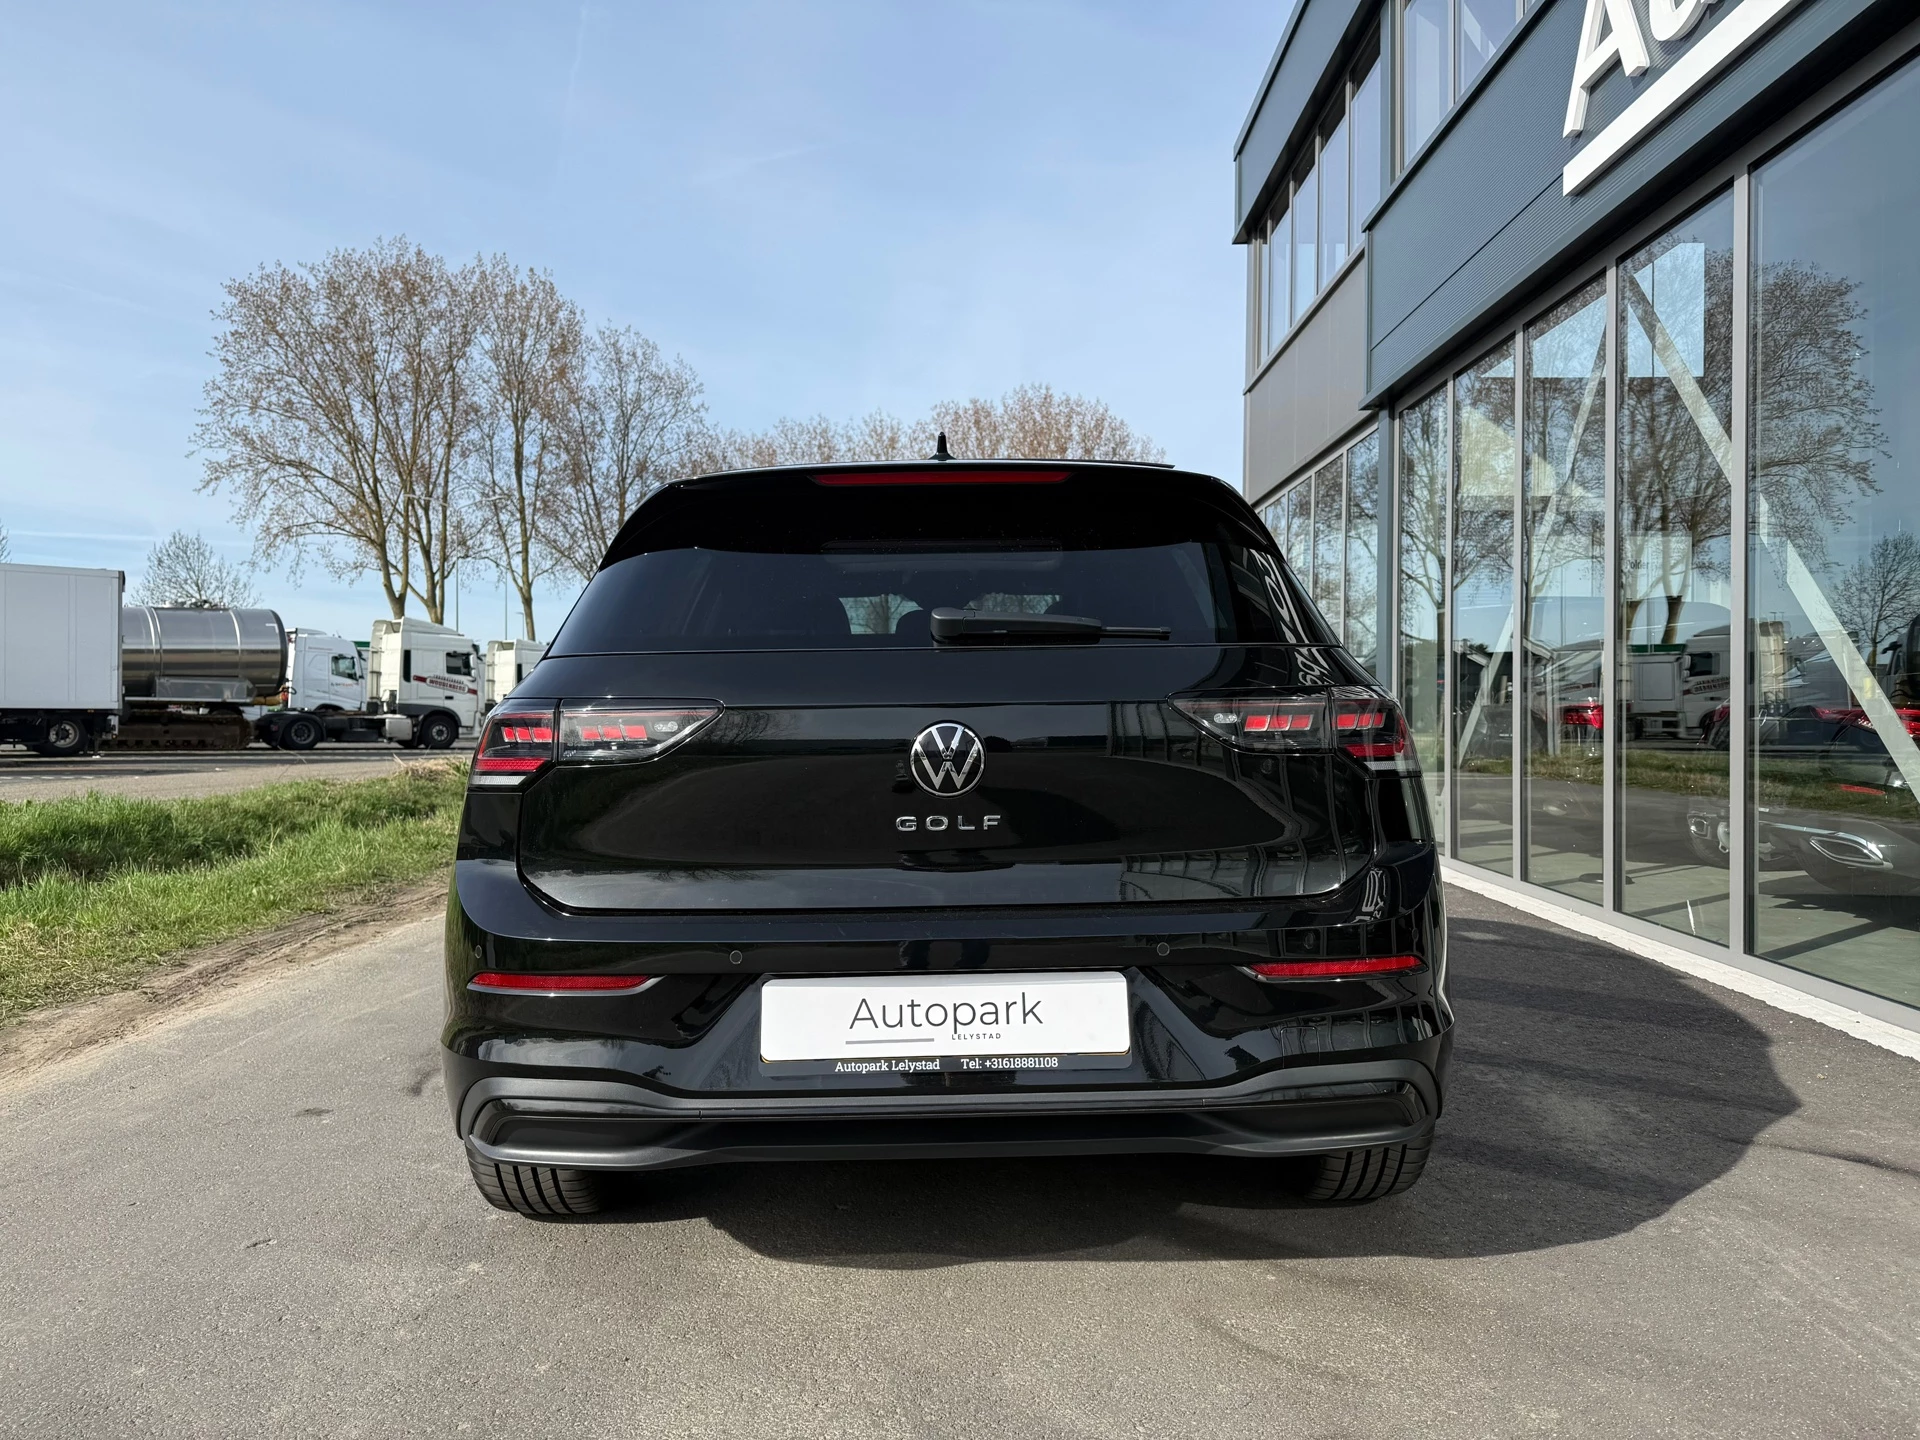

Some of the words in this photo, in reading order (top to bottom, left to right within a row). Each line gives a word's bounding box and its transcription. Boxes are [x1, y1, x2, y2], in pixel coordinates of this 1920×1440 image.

[895, 815, 1001, 831] GOLF
[848, 991, 1044, 1034] Autopark
[951, 1032, 1002, 1041] LELYSTAD
[835, 1060, 889, 1073] Autopark
[891, 1059, 940, 1073] Lelystad
[961, 1058, 982, 1070] Tel:
[984, 1056, 1059, 1070] +31618881108
